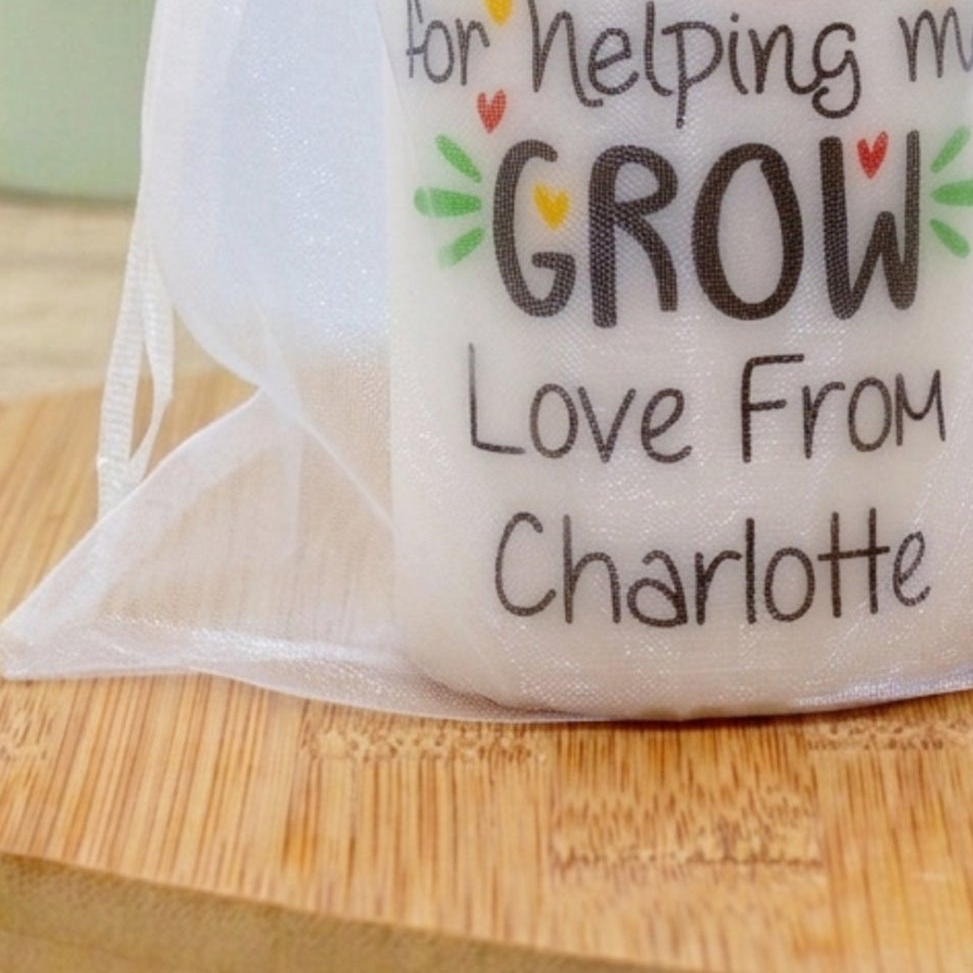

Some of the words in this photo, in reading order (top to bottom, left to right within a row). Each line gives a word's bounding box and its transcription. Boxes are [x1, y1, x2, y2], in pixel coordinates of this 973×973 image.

[492, 129, 921, 328] GROW
[467, 342, 693, 464] Love
[740, 353, 947, 464] From
[494, 507, 932, 629] Charlotte
